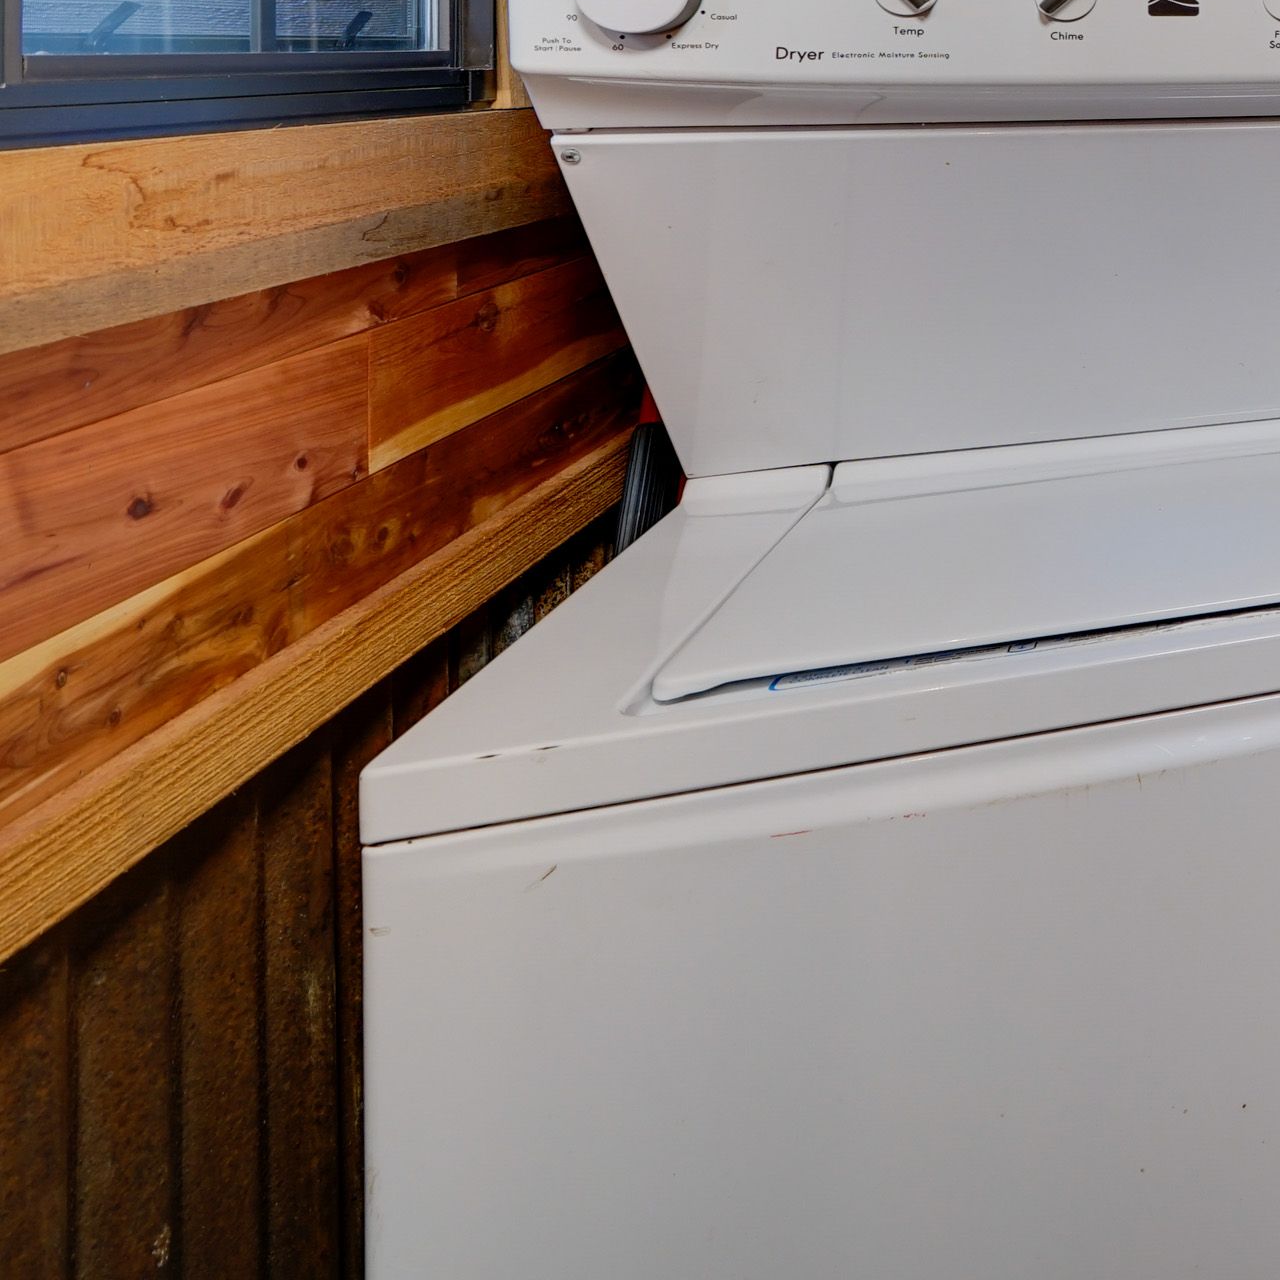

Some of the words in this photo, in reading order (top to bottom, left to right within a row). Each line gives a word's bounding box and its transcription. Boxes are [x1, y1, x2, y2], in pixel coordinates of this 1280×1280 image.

[710, 13, 738, 21] Casual
[893, 26, 924, 37] Temp
[1050, 31, 1084, 41] Chime
[612, 43, 624, 51] 60
[671, 42, 702, 50] Express
[705, 42, 719, 50] Dry
[775, 46, 825, 63] Dryer
[832, 51, 875, 59] Electronic
[879, 51, 915, 59] Moisture
[918, 51, 950, 60] Sensing
